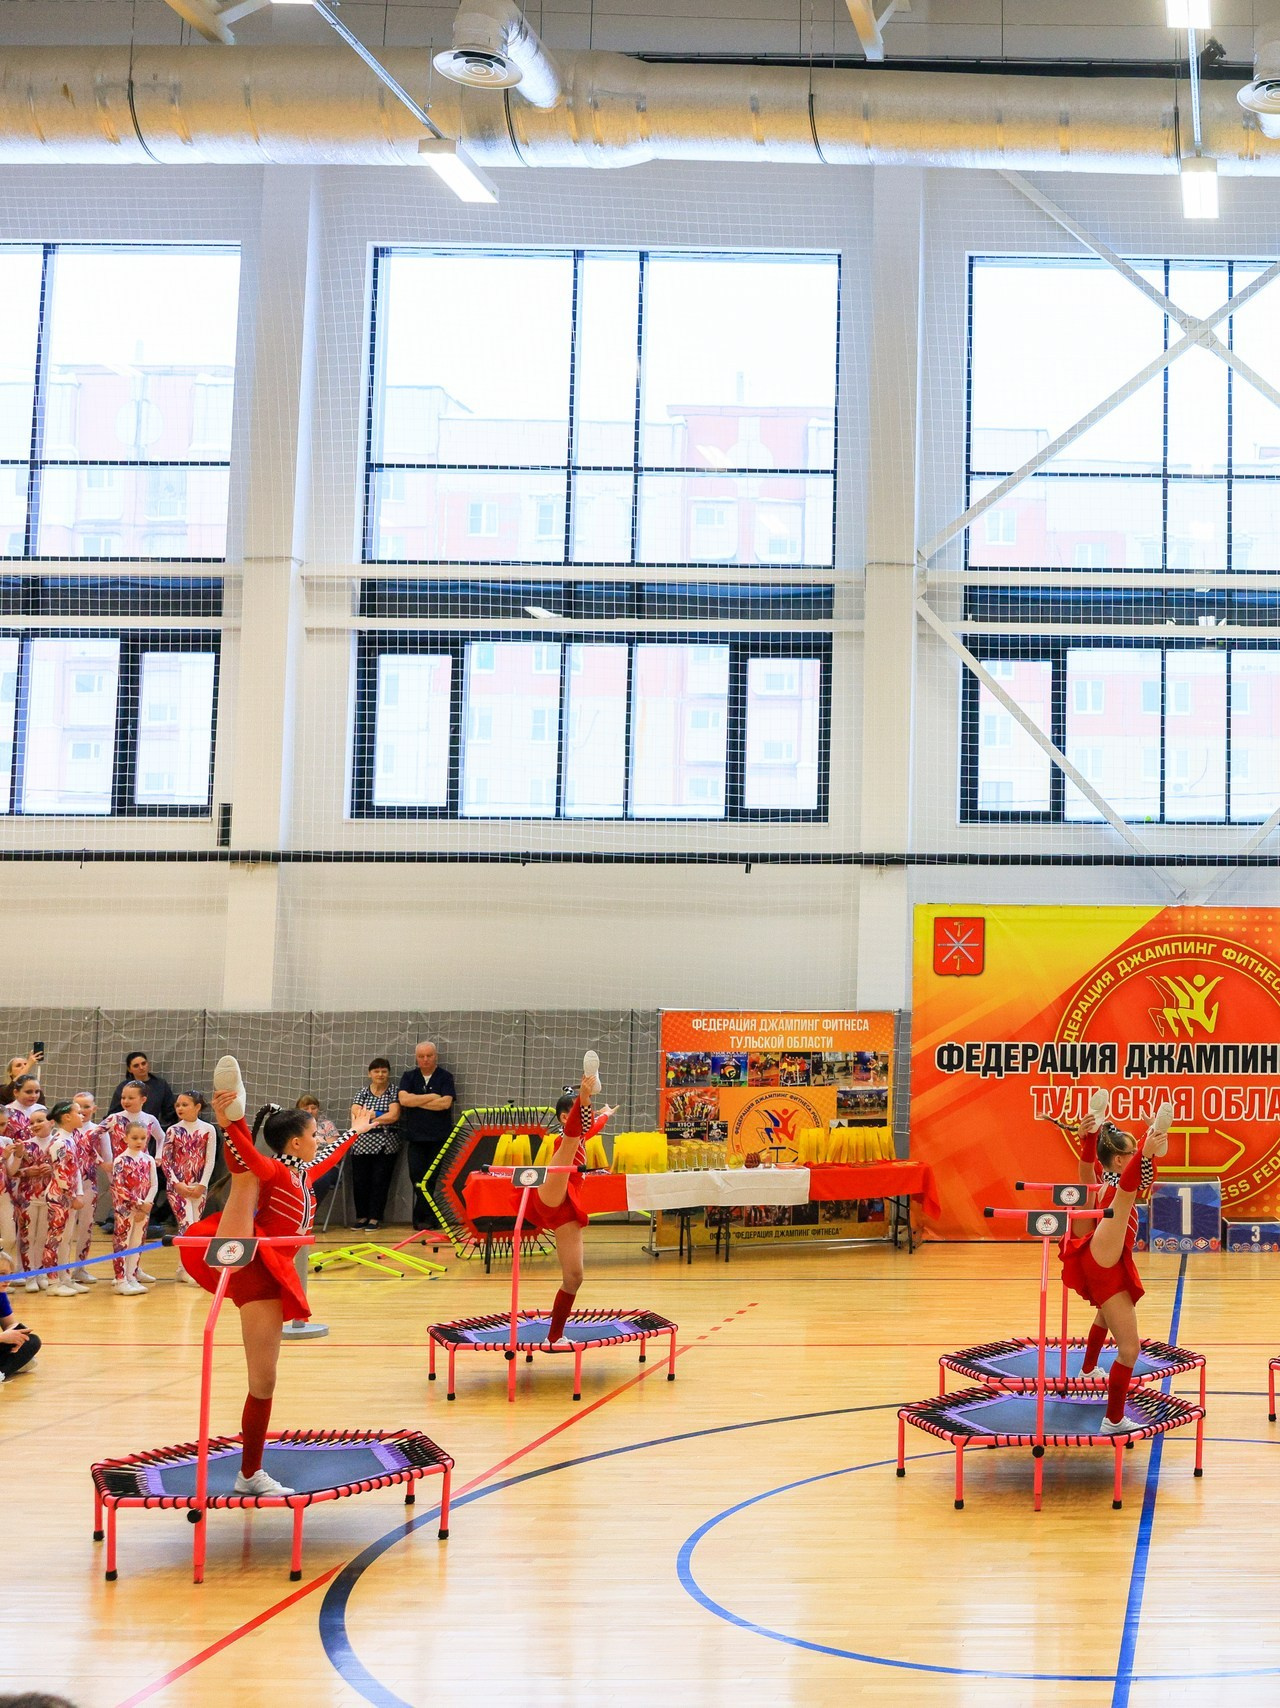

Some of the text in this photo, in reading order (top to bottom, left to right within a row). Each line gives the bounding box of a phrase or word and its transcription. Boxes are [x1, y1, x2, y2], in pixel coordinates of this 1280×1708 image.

[1063, 971, 1116, 1044] ДЕРАЦИЯ
[1116, 941, 1217, 978] ДЖАМПИНГ
[692, 1018, 869, 1033] ФЕДЕРАЦИЯ ДЖАМПИНГ ФИТНЕСА
[730, 1034, 833, 1049] ТУЛЬСКОЙ ОБЛАСТИ
[935, 1042, 1117, 1079] ФЕДЕРАЦИЯ
[1030, 1085, 1195, 1121] ТУЛСКАЯ
[1177, 1188, 1192, 1235] 1
[1251, 1225, 1260, 1242] 3
